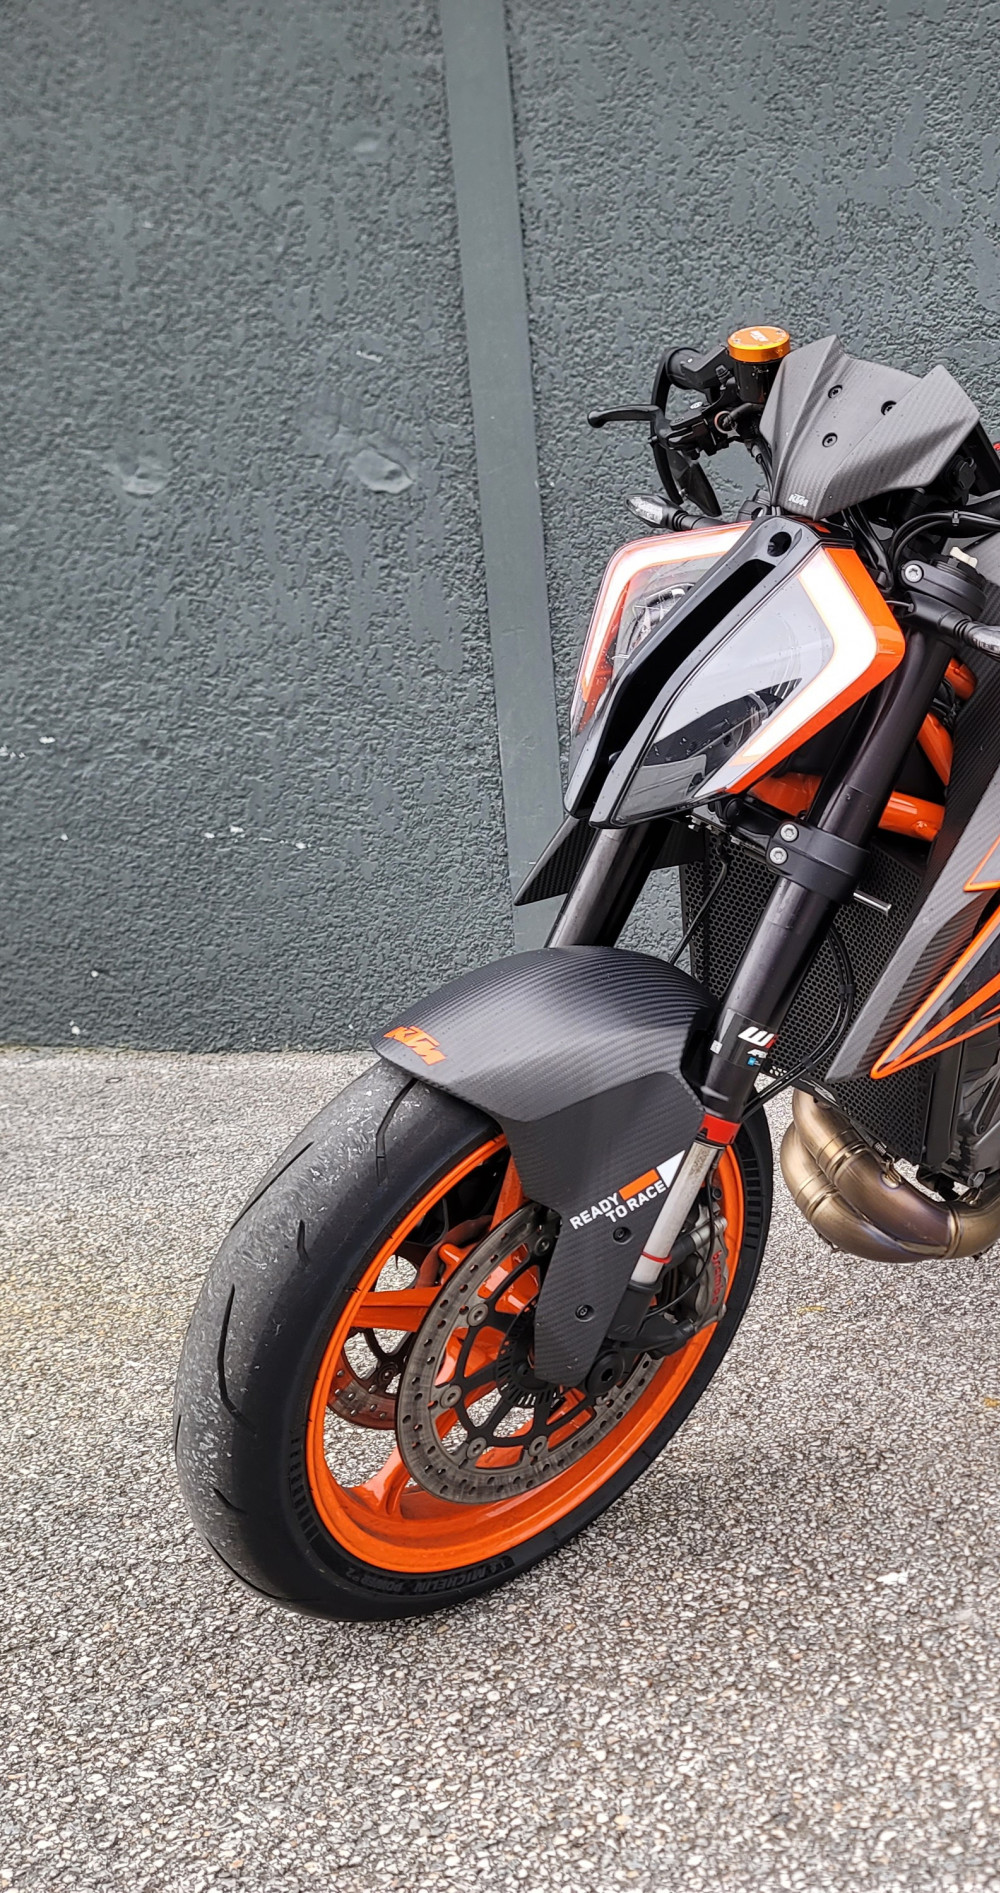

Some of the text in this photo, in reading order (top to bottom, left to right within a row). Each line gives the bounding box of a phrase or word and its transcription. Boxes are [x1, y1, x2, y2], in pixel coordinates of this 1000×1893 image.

[788, 493, 809, 507] KTM
[383, 1025, 447, 1066] KTM
[569, 1192, 619, 1230] READY
[605, 1179, 667, 1223] TO RACE
[711, 1250, 723, 1306] brembo
[414, 1569, 487, 1593] MICHELIN
